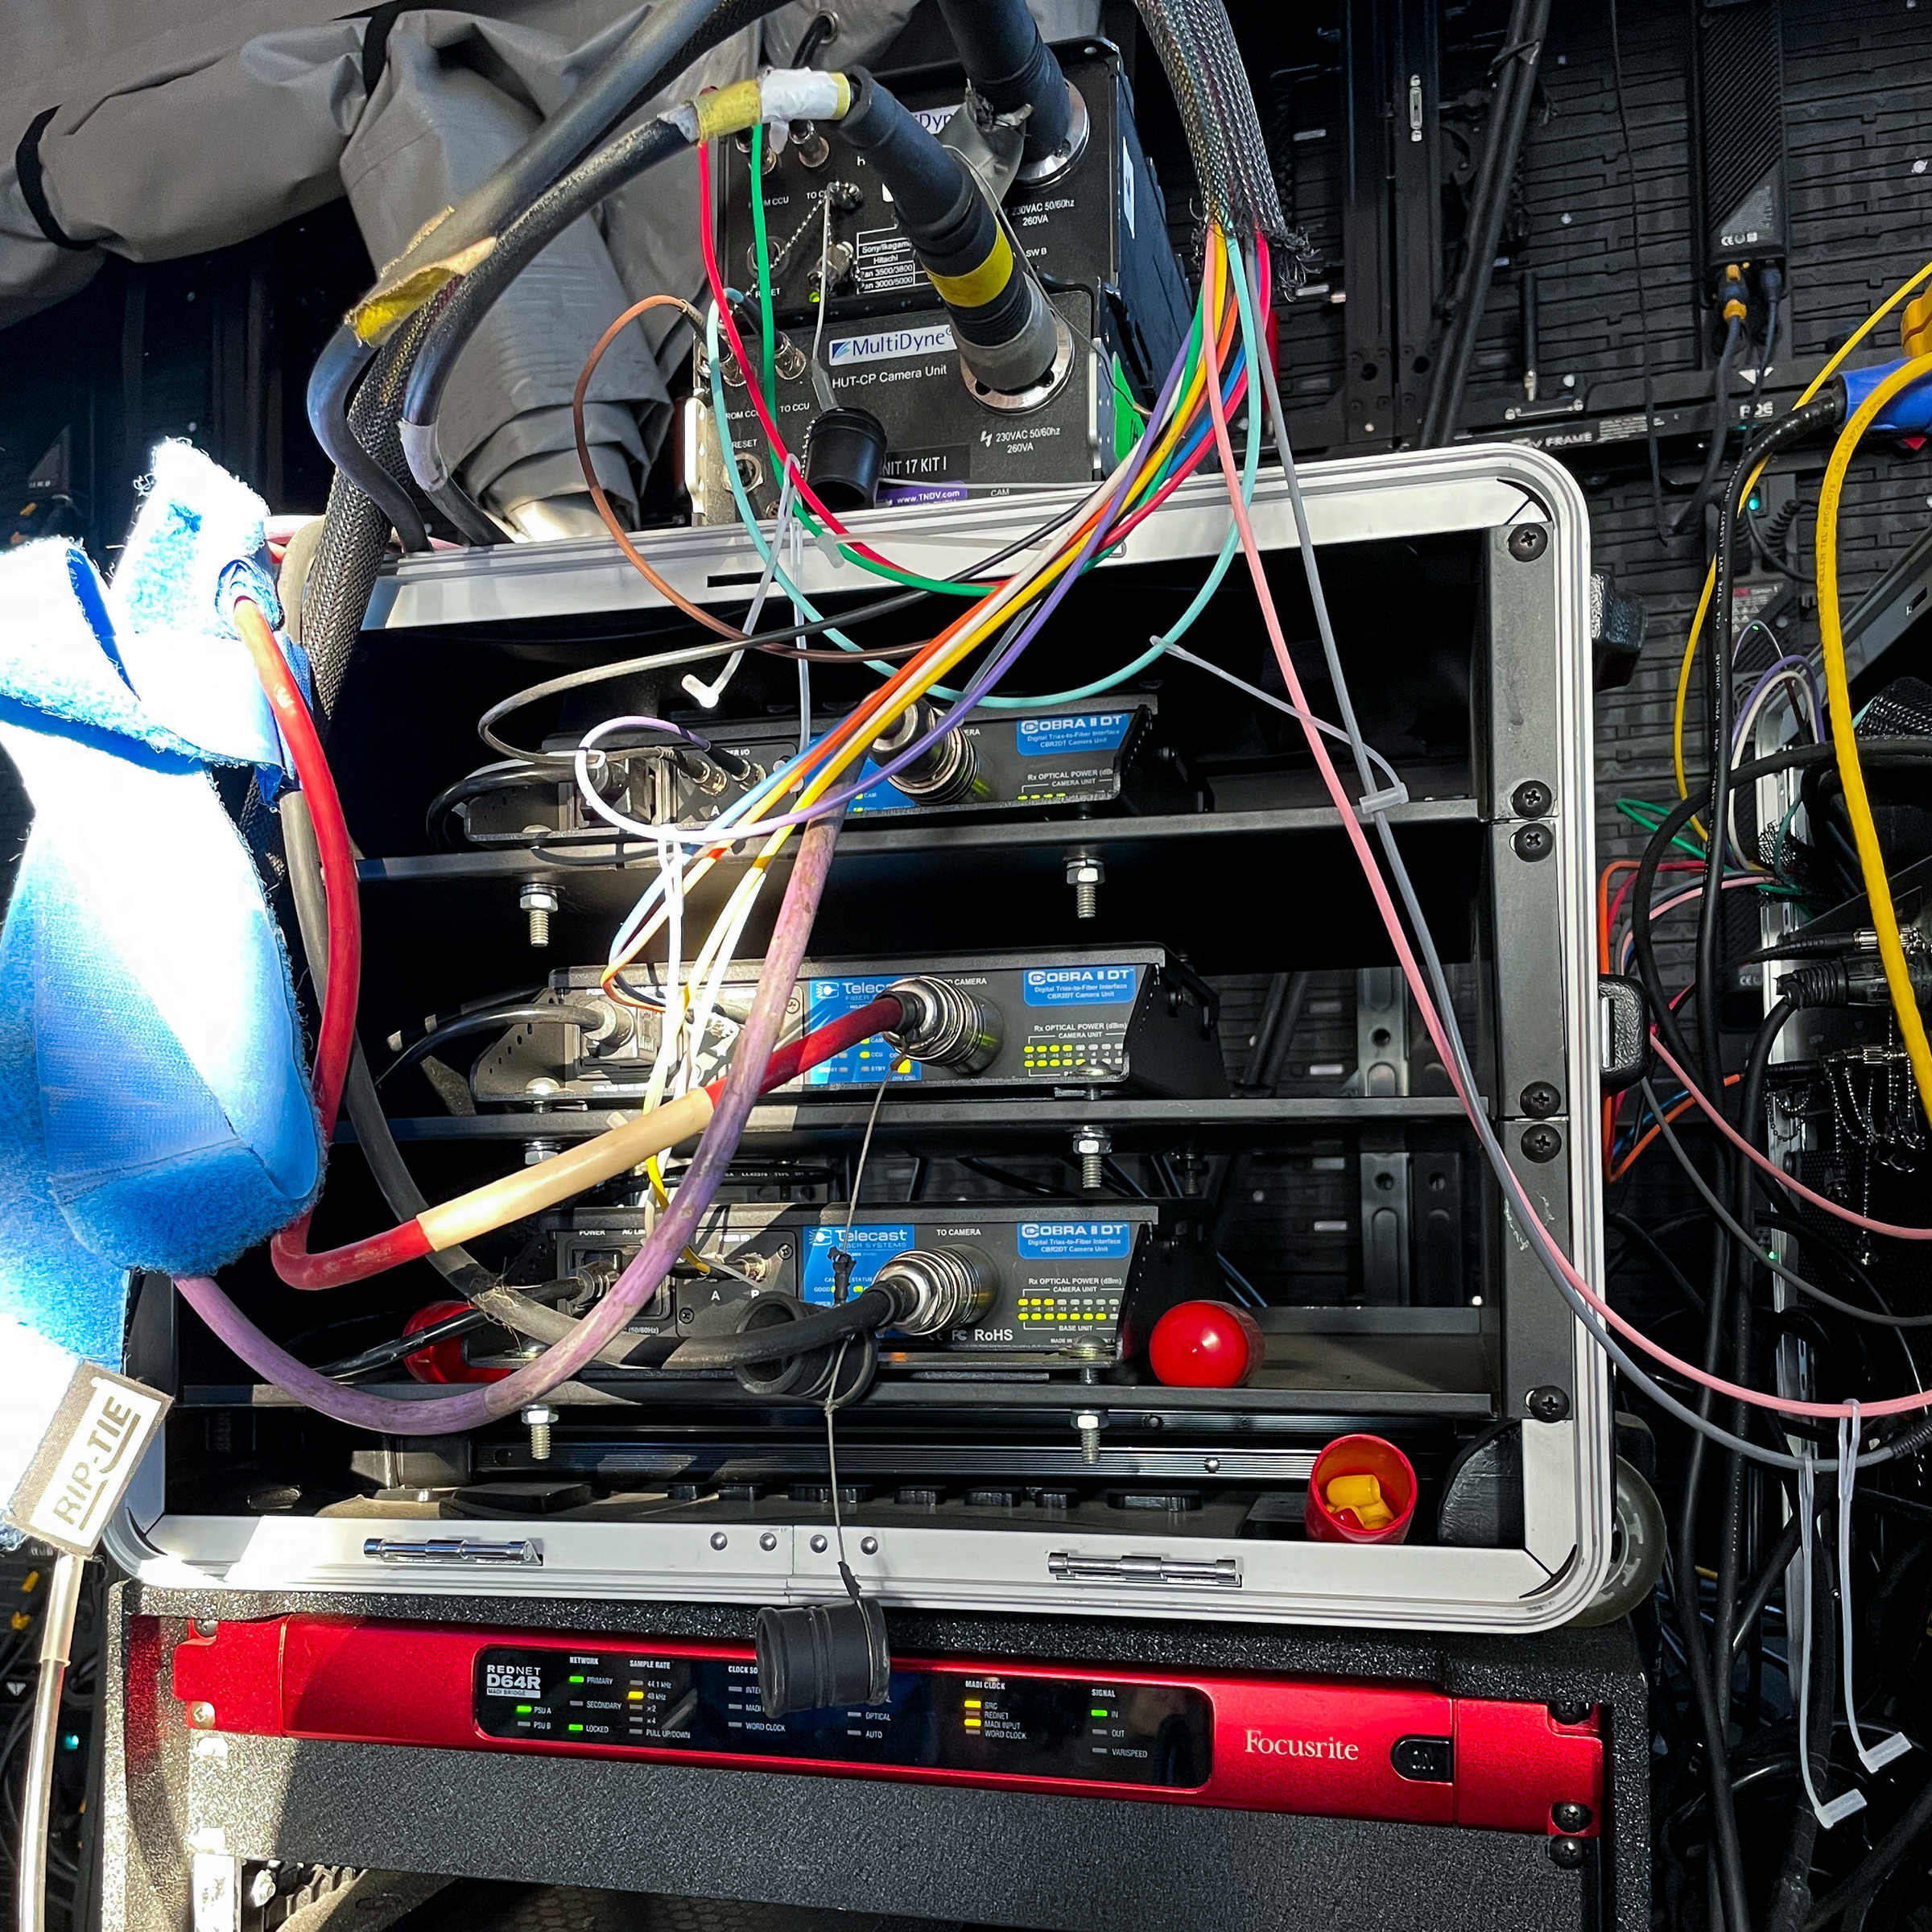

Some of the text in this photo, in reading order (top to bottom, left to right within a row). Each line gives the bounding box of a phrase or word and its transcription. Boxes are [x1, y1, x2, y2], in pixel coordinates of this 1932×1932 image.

[772, 196, 790, 205] CCU
[807, 192, 818, 200] TO
[1022, 216, 1049, 227] 260VA
[873, 254, 899, 265] Hitachi
[755, 287, 781, 298] RET
[852, 332, 945, 357] MultiDyne
[832, 364, 947, 390] HUT-CP Camera Unit
[779, 402, 810, 412] TO CCU
[725, 411, 744, 419] ROM
[996, 427, 1061, 443] 230VAC 50/60hz
[732, 439, 758, 449] RESET
[1007, 443, 1034, 454] 260VA
[905, 459, 918, 473] 17
[920, 456, 940, 472] KIT
[897, 489, 960, 504] www.TNDV.com
[990, 488, 1010, 497] CAM
[1021, 718, 1087, 734] COBRA
[1038, 771, 1069, 779] OPTICAL
[1071, 770, 1098, 778] POWER
[1051, 779, 1080, 787] CAMERA
[954, 977, 987, 985] CAMERA
[1028, 971, 1093, 985] COBRA
[841, 982, 892, 995] Telec
[1034, 985, 1055, 993] Digital
[1045, 1023, 1075, 1031] OPTICAL
[835, 1229, 908, 1242] Telecast
[948, 1228, 981, 1236] CAMERA
[1022, 1224, 1088, 1238] COBRA
[1100, 1278, 1122, 1286] (dBm)
[711, 1290, 720, 1301] A
[974, 1329, 1013, 1341] RoHS
[53, 1395, 132, 1526] RIP-TIE
[569, 1656, 599, 1665] NETWORK
[630, 1660, 671, 1670] SAMPLE RATE
[486, 1664, 542, 1675] REDNET
[728, 1666, 749, 1674] CLOCK
[486, 1674, 541, 1690] D64R
[586, 1676, 613, 1686] PRIMARY
[660, 1681, 672, 1690] kHz
[965, 1680, 1005, 1690] MADI CLOCK
[1091, 1689, 1116, 1698] SIGNAL
[586, 1700, 622, 1711] SECONDARY
[534, 1707, 546, 1715] PSU
[865, 1711, 891, 1721] OPTICAL
[984, 1711, 1009, 1719] REDNET
[1111, 1711, 1119, 1719] IN
[534, 1721, 546, 1729] PSU
[586, 1724, 609, 1733] LOCKED
[745, 1722, 786, 1732] WORD CLOCK
[984, 1720, 1021, 1730] MADI INPUT
[646, 1729, 691, 1740] PULL UP/DOWN
[865, 1730, 882, 1739] AUTO
[985, 1731, 1027, 1740] WORD CLOCK
[1111, 1729, 1125, 1738] OUT
[1244, 1729, 1360, 1761] Focusrite
[1112, 1748, 1148, 1758] VARISPEED
